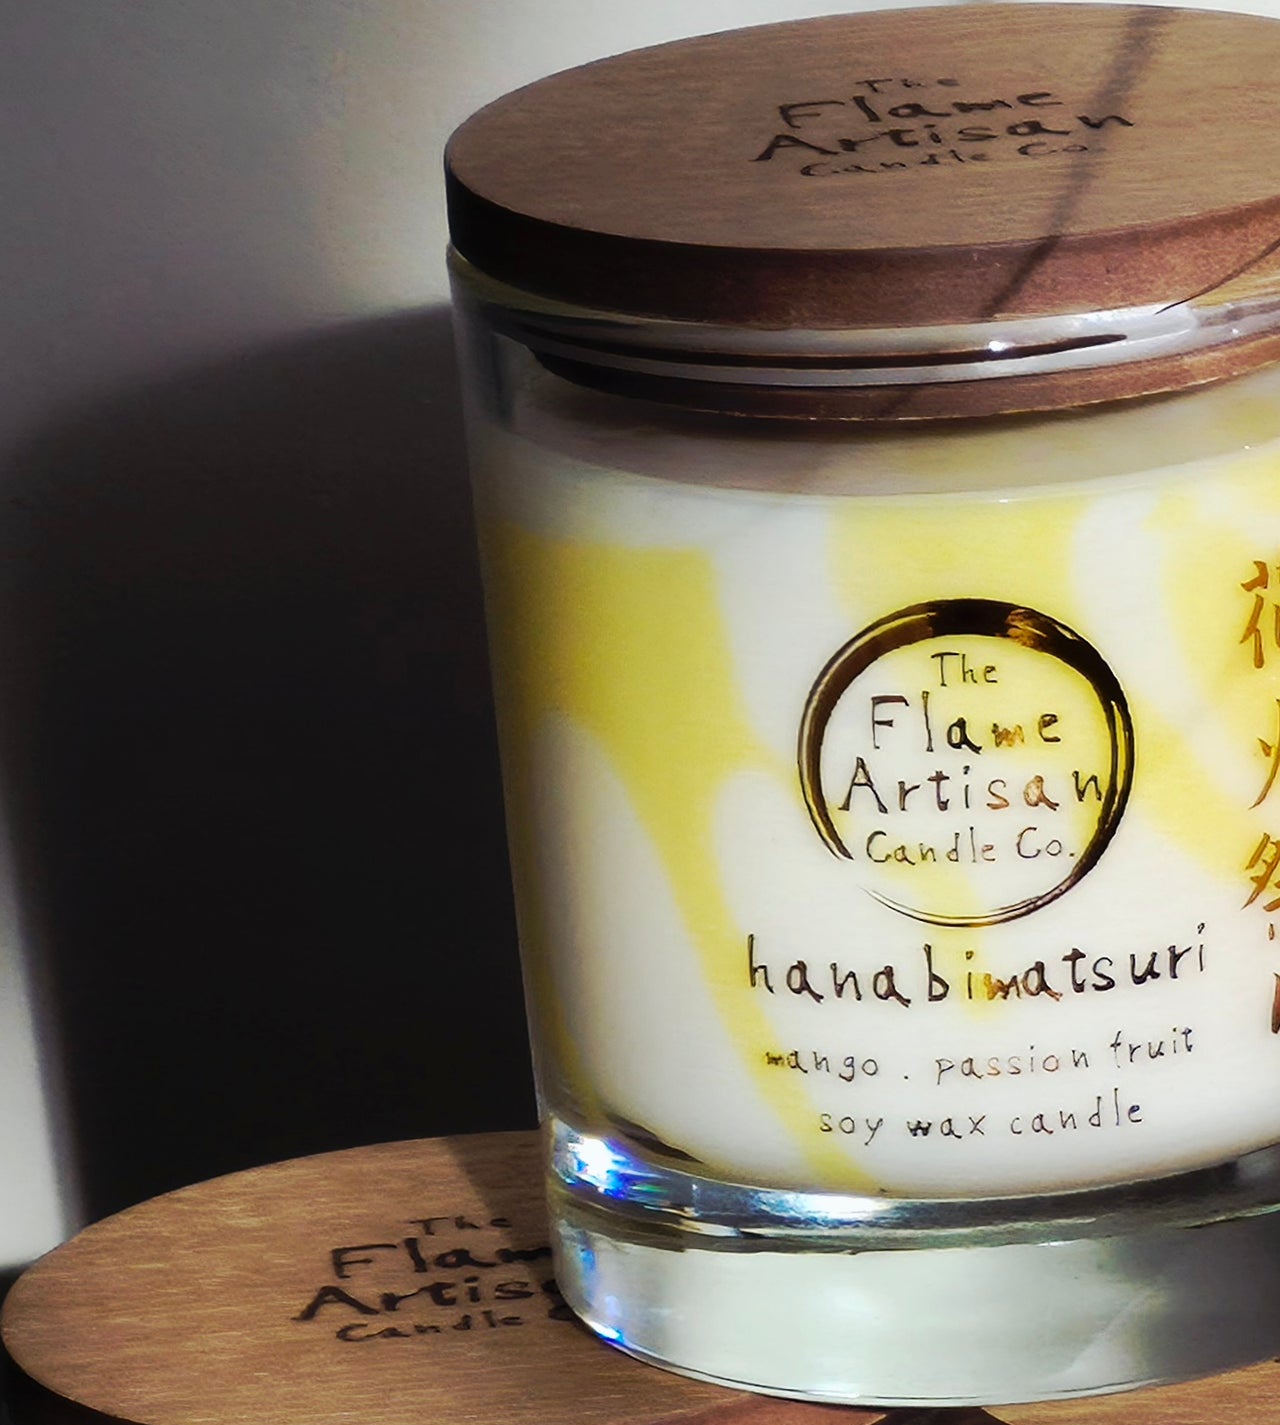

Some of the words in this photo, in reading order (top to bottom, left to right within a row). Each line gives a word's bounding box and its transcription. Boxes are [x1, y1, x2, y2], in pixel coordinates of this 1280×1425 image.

[854, 77, 960, 93] The
[778, 92, 1064, 129] Flame
[748, 113, 1135, 162] Artisan
[800, 147, 993, 177] Candle
[930, 650, 999, 688] The
[869, 690, 1062, 755] Flame
[838, 756, 1104, 815] Artisan
[866, 826, 996, 865] Candle
[1014, 825, 1076, 860] Co.
[745, 922, 1208, 1008] hanabimatsuri
[764, 1048, 879, 1083] mango
[933, 1043, 1091, 1087] passion
[1108, 1026, 1195, 1070] fruit
[818, 1110, 885, 1146] soy
[906, 1111, 987, 1139] wax
[1009, 1086, 1145, 1136] candle
[407, 1215, 513, 1236] The
[330, 1236, 553, 1280] Flam
[289, 1275, 562, 1322] Artis
[335, 1308, 524, 1343] Candle
